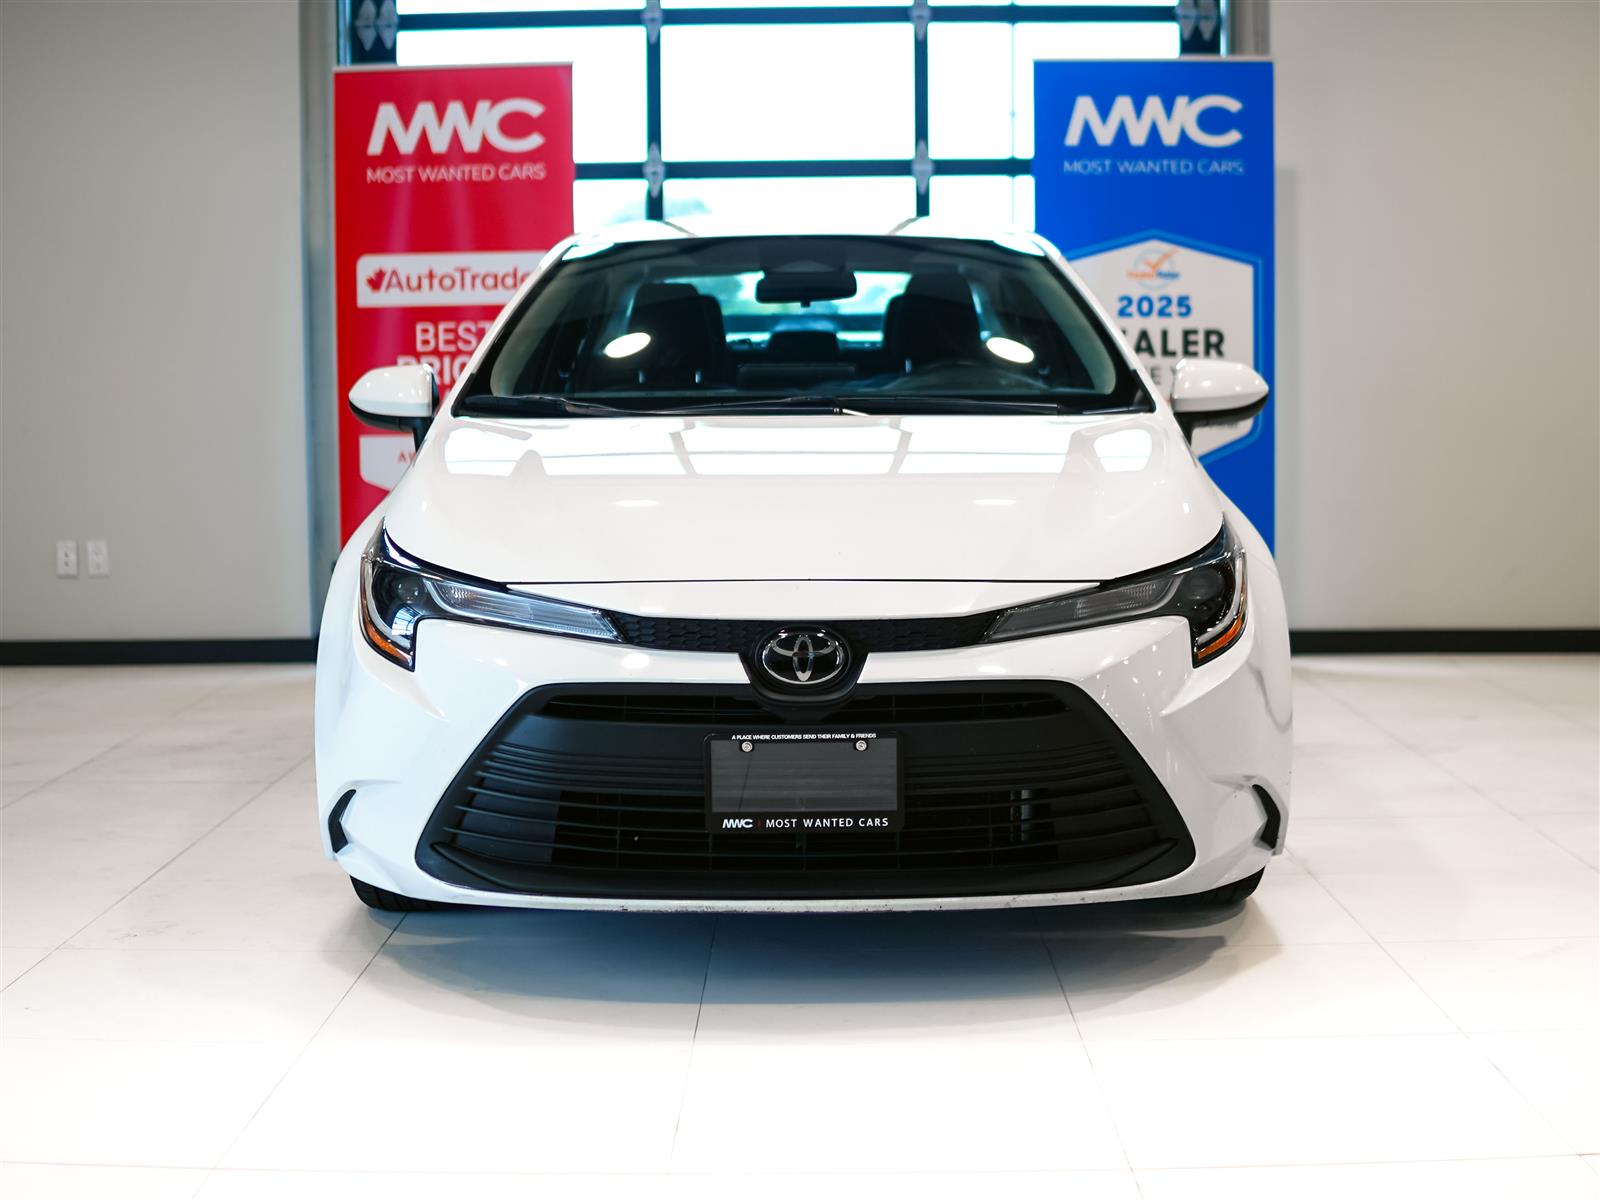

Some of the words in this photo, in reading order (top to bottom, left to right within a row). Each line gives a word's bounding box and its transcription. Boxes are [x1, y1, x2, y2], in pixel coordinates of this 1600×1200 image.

[367, 97, 545, 156] MWC
[1064, 94, 1243, 148] MWC
[366, 166, 414, 184] MOST
[418, 164, 494, 182] WANTED
[498, 162, 546, 181] CARS
[1063, 159, 1112, 175] MOST
[1117, 159, 1193, 174] WANTED
[1197, 159, 1244, 174] CARS
[1117, 295, 1192, 318] 2025
[722, 818, 753, 829] MWC
[765, 818, 798, 828] MOST
[802, 817, 854, 828] WANTED
[858, 817, 889, 827] CARS
